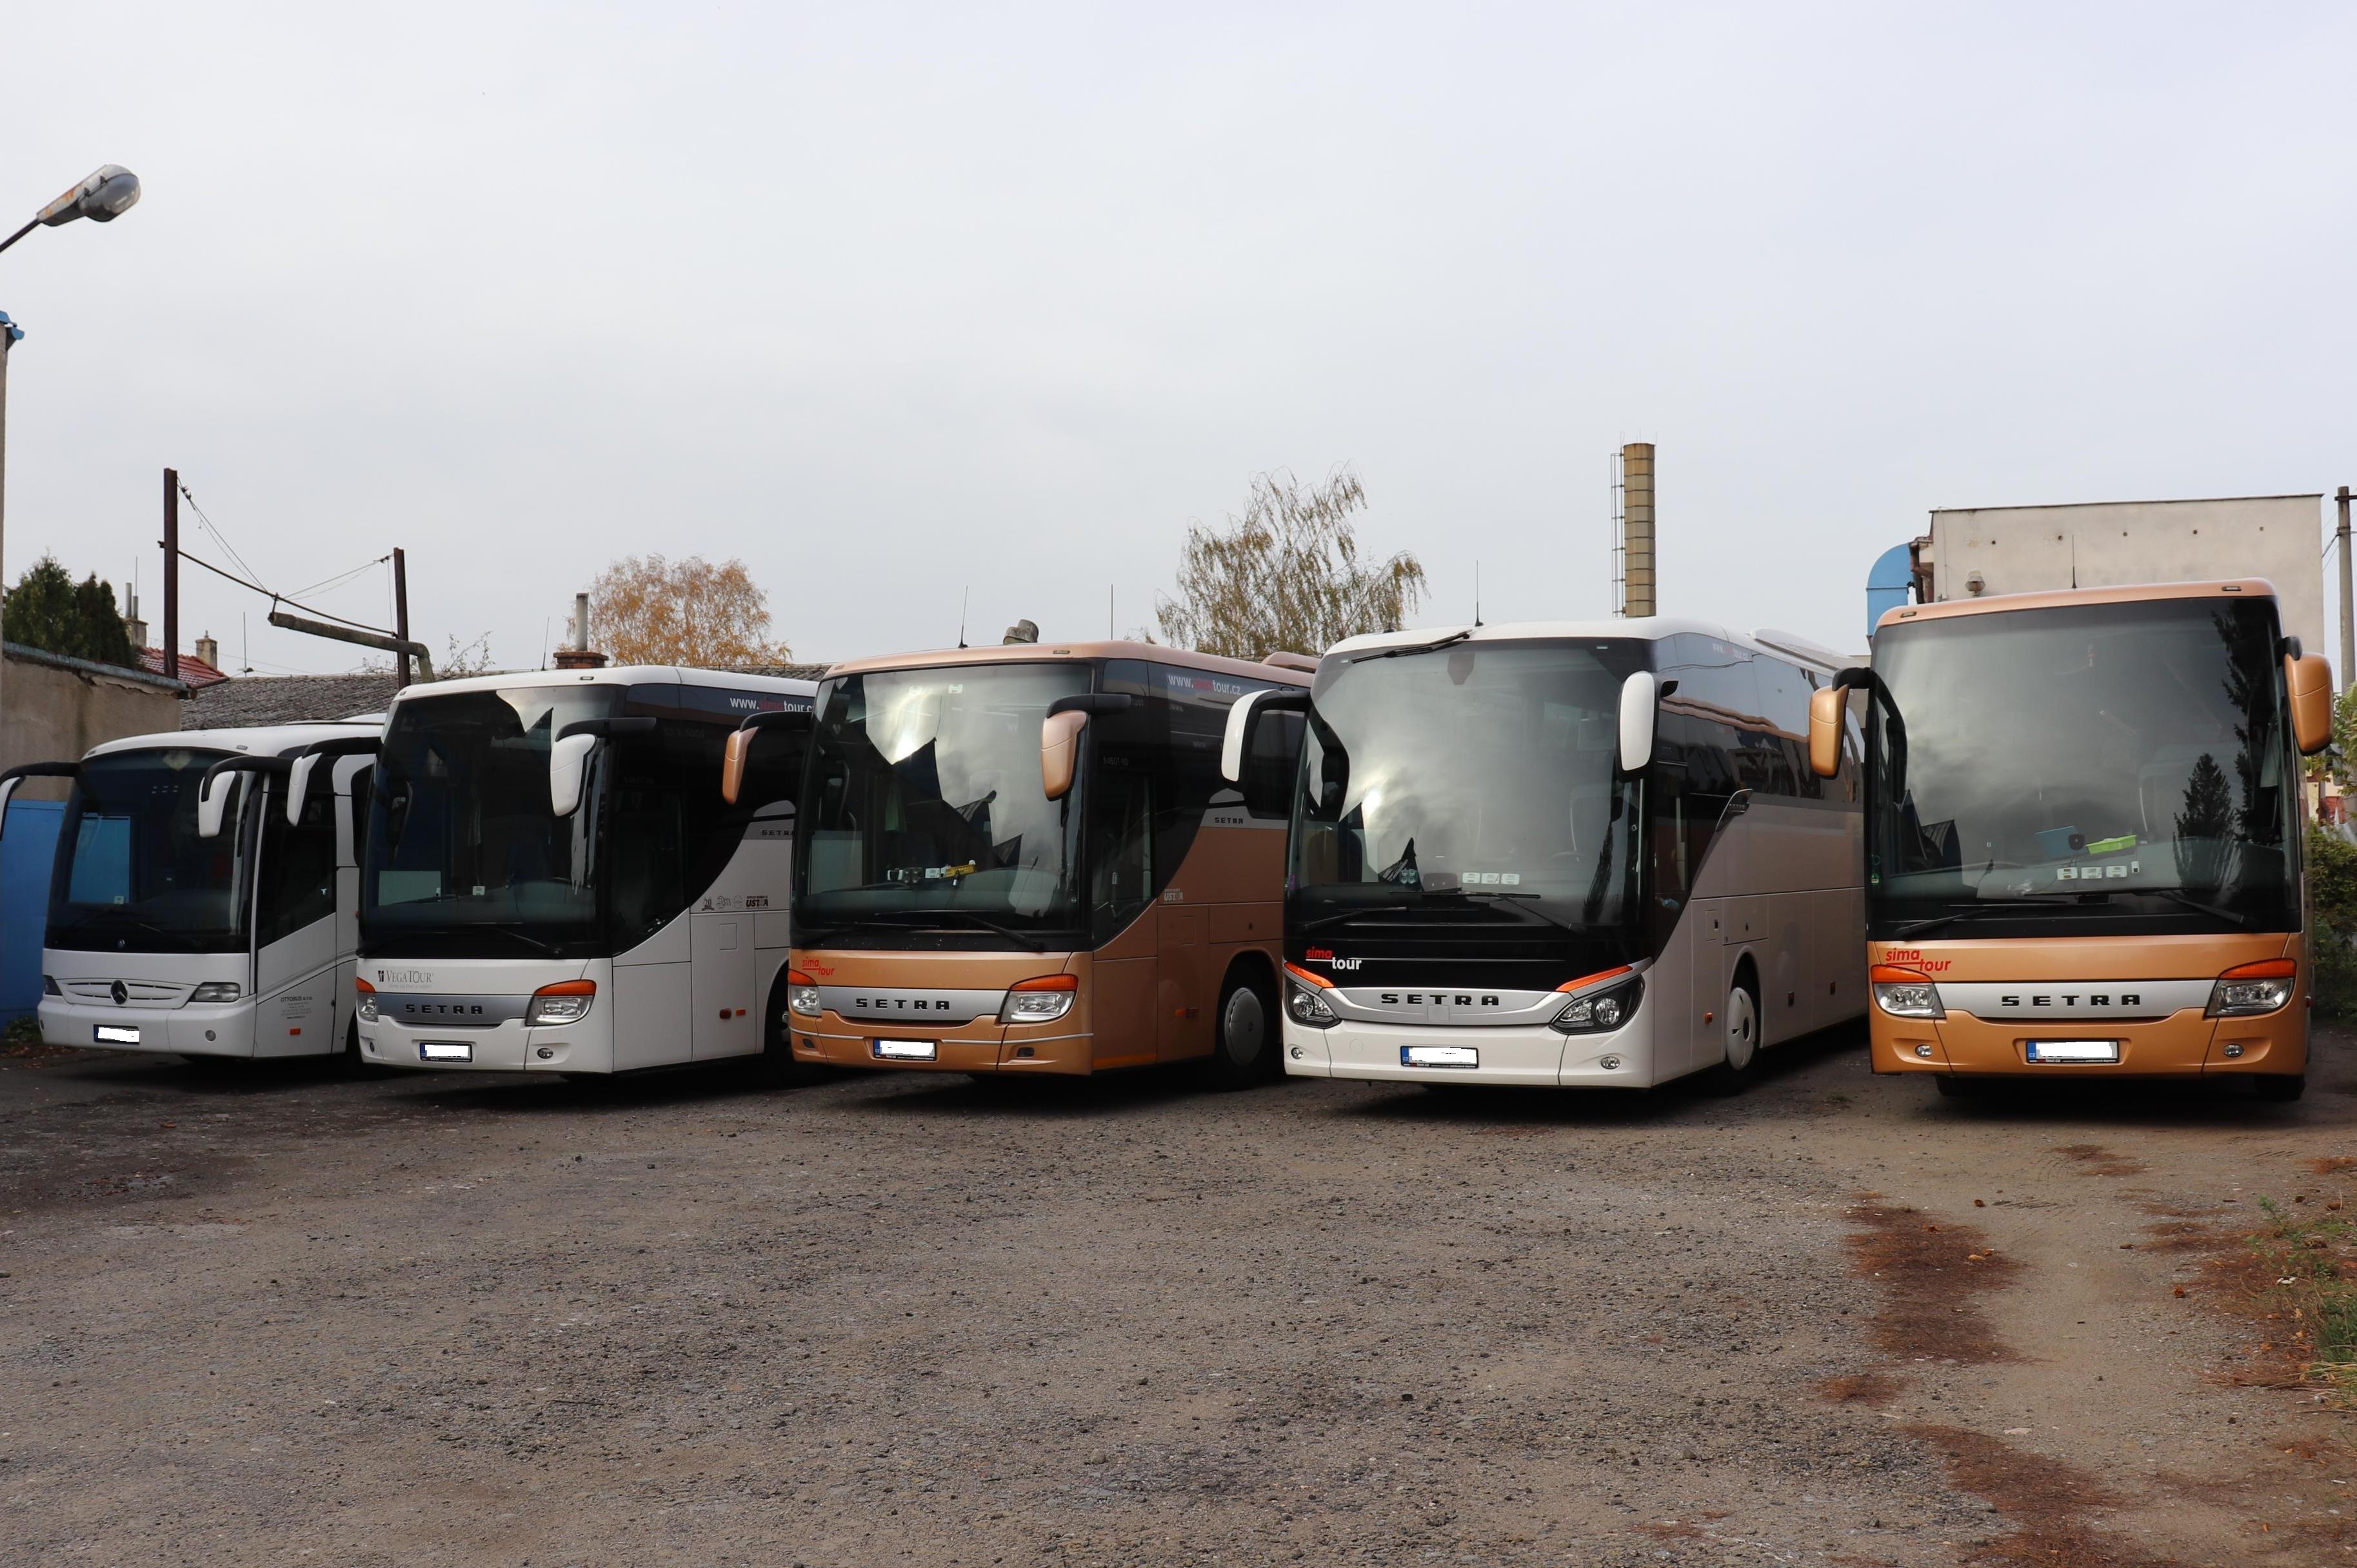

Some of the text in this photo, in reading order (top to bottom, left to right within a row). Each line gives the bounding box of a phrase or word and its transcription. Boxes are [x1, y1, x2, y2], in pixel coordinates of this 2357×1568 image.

[1306, 946, 1333, 959] sima
[1885, 948, 1920, 961] sima
[802, 957, 819, 967] sima
[1331, 957, 1362, 970] tour
[1919, 958, 1951, 971] tour
[818, 966, 835, 975] tour
[856, 998, 950, 1009] SETRA
[1381, 993, 1499, 1006] SETRA
[2001, 995, 2140, 1006] SETRA
[406, 1004, 483, 1015] SETRA
